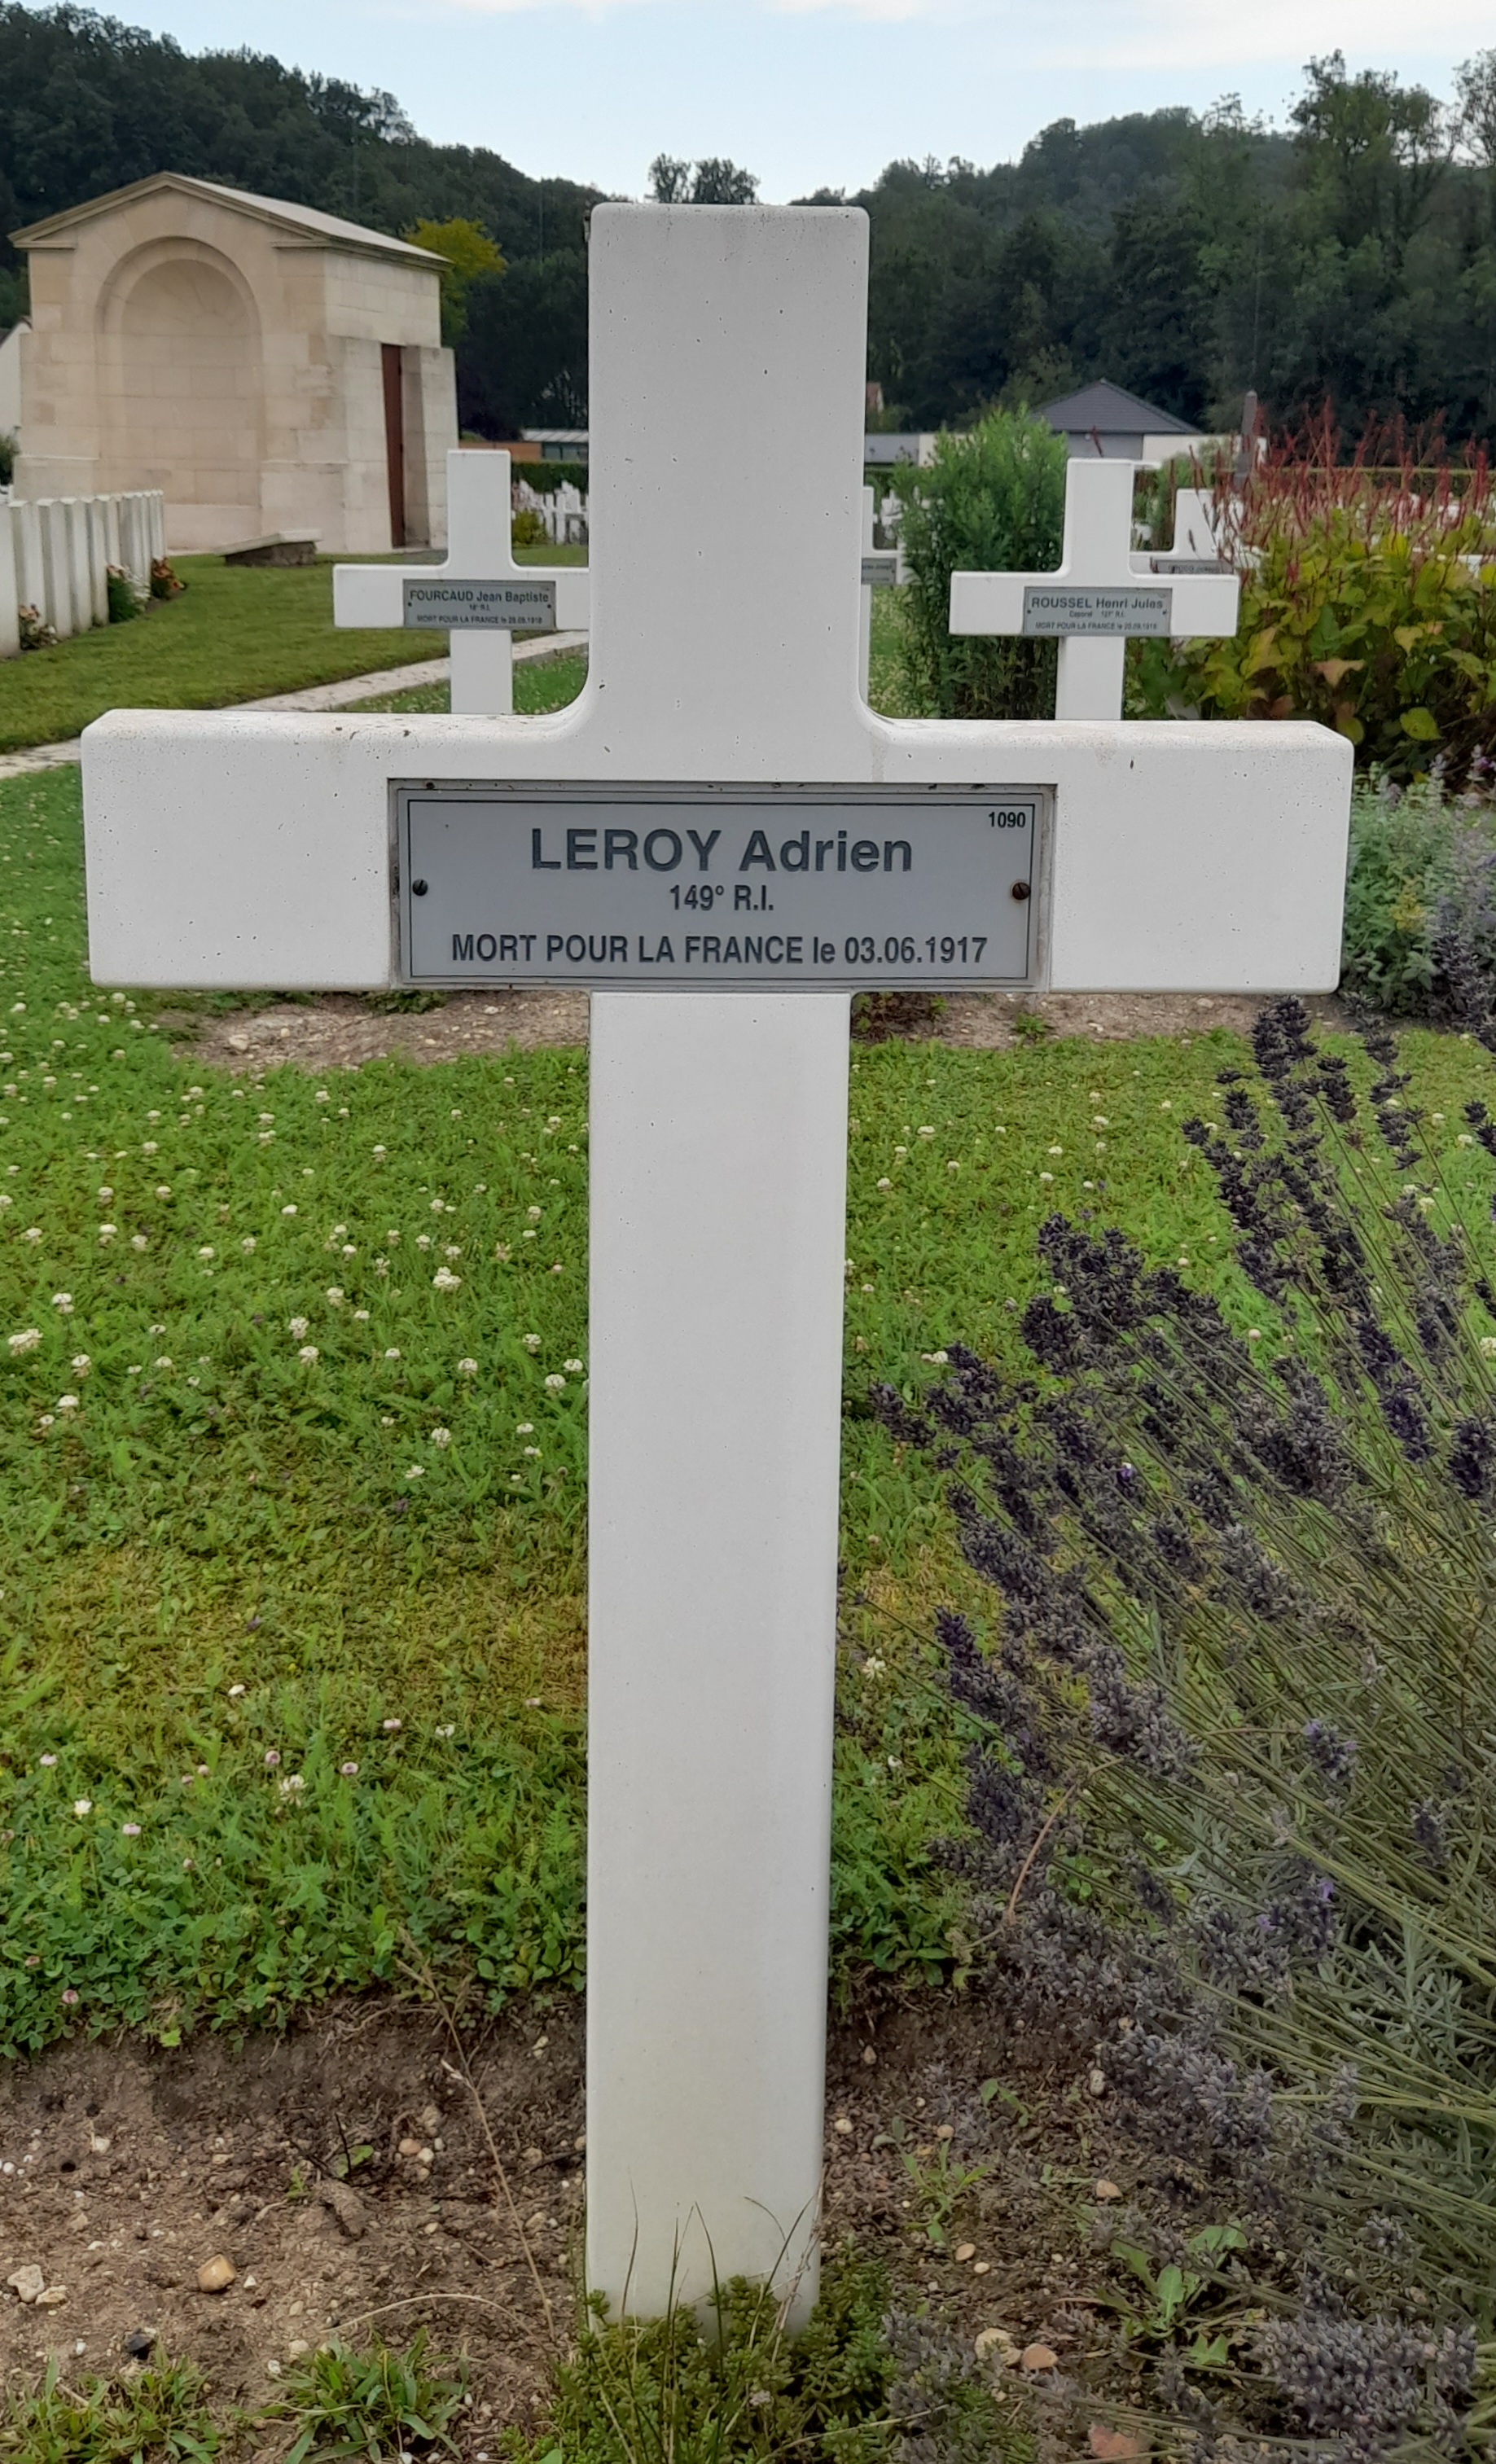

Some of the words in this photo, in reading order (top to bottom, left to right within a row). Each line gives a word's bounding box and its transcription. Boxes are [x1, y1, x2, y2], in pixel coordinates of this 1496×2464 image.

[410, 590, 473, 602] FOURCAUD
[476, 591, 502, 602] Jean
[505, 591, 549, 604] Baptiste
[1031, 596, 1092, 608] ROUSSEL
[1096, 598, 1128, 608] Henri
[1131, 598, 1164, 609] Jules
[417, 615, 437, 623] MORT
[1035, 621, 1055, 629] MORT
[1088, 622, 1116, 630] FRANCE
[988, 811, 1025, 828] 1090
[532, 827, 722, 871] LEROY
[739, 829, 912, 872] Adrien
[669, 884, 725, 911] 149°
[734, 885, 774, 911] R.I.
[452, 933, 537, 962] MORT
[546, 934, 629, 963] POUR
[638, 935, 675, 964] LA
[685, 936, 804, 964] FRANCE
[813, 936, 836, 964] le
[845, 936, 989, 964] 03.06.1917
